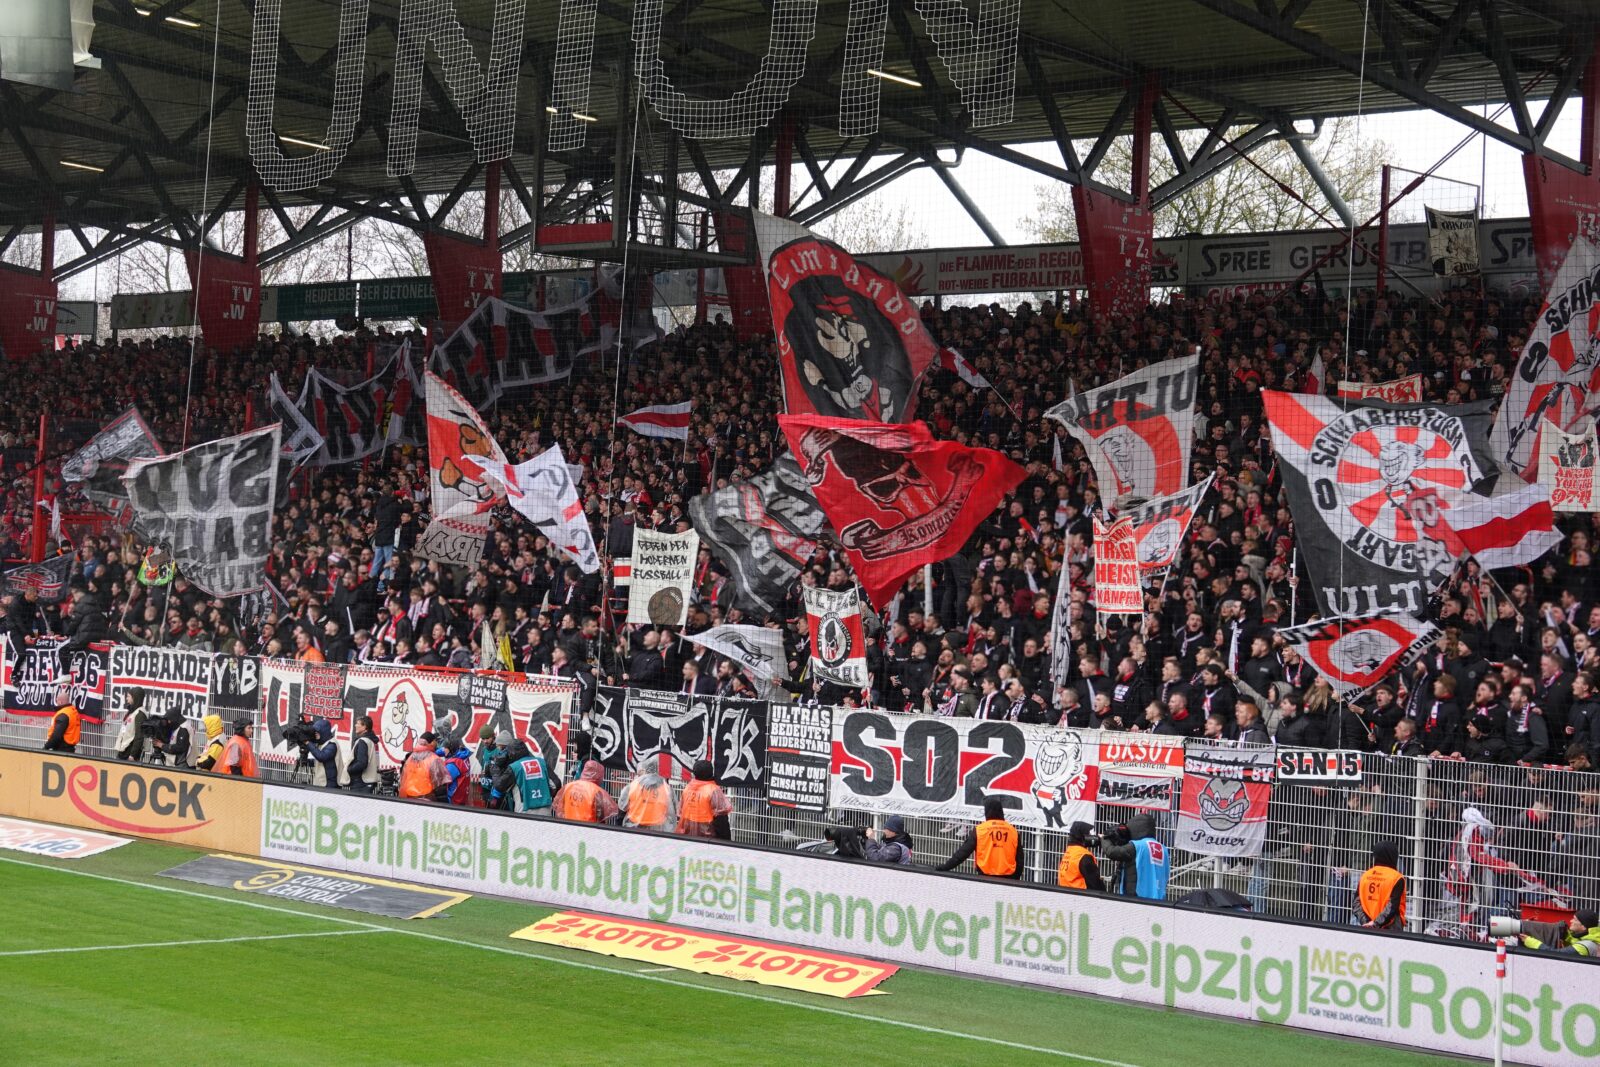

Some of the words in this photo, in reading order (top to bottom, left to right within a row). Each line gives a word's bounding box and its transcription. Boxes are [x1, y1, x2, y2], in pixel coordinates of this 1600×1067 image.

[939, 262, 954, 272] DIE
[956, 254, 1015, 272] FLAMME
[1038, 251, 1086, 268] REGIO
[1202, 241, 1271, 277] SPREE
[242, 287, 253, 301] V
[45, 300, 55, 315] V
[229, 304, 245, 320] W
[33, 316, 48, 332] W
[637, 540, 668, 551] GEGEN
[669, 541, 689, 551] DEN
[639, 554, 688, 566] MODERNEN
[633, 568, 682, 580] FUSSBALL
[471, 687, 503, 702] IMMER
[486, 679, 505, 691] BIST
[469, 696, 484, 706] BEI
[771, 704, 832, 728] ULTRAS
[770, 723, 832, 742] BEDEUTET
[769, 736, 832, 755] WIDERSTAND
[771, 761, 804, 779] KAMPF
[806, 766, 828, 780] UND
[1184, 758, 1244, 779] SEKTION
[1280, 751, 1328, 776] SLN
[531, 788, 543, 799] 21
[769, 789, 796, 802] UNSERE
[770, 777, 808, 793] EINSATZ
[808, 780, 826, 795] FÜR
[271, 799, 309, 822] MEGA
[839, 795, 876, 810] Ultras
[270, 820, 310, 845] ZOO
[314, 806, 418, 871] Berlin
[430, 820, 473, 846] MEGA
[988, 830, 1009, 843] 101
[1190, 829, 1247, 847] Power
[429, 843, 473, 870] ZOO
[479, 828, 675, 922] Hamburg
[687, 858, 738, 885] MEGA
[267, 883, 348, 904] CENTRAL
[290, 873, 374, 895] COMEDY
[685, 881, 737, 910] ZOO
[745, 866, 990, 961] Hannover
[1005, 902, 1067, 933] MEGA
[575, 924, 687, 951] LOTTO
[1004, 929, 1067, 962] ZOO
[738, 950, 861, 983] LOTTO
[1077, 912, 1293, 1025] Leipzig
[1311, 947, 1385, 981] MEGA
[1309, 976, 1386, 1012] ZOO
[1398, 960, 1600, 1058] Rosto
